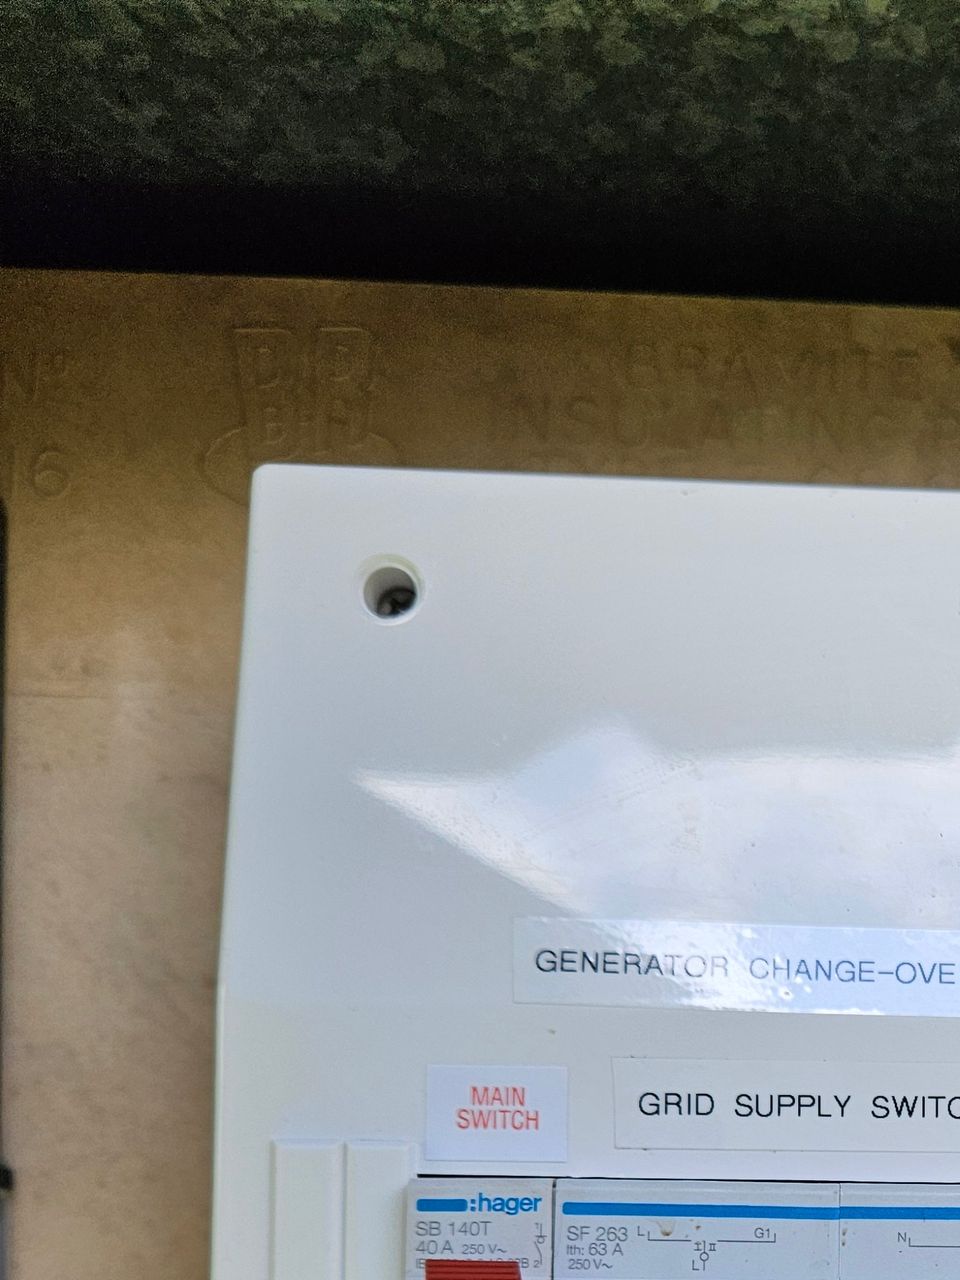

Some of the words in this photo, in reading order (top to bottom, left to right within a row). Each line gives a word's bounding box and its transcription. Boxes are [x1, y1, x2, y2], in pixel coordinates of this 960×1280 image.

[533, 947, 731, 978] GENERATOR
[470, 1085, 526, 1107] MAIN
[638, 1092, 715, 1116] GRID
[734, 1093, 851, 1118] SUPPLY
[456, 1108, 541, 1131] SWITCH
[415, 1220, 441, 1237] SB
[448, 1220, 493, 1237] 140T
[566, 1225, 591, 1242] SF
[595, 1226, 628, 1242] 263
[752, 1226, 773, 1241] G1
[897, 1231, 908, 1243] N
[415, 1239, 438, 1255] 40
[440, 1239, 454, 1254] A
[461, 1243, 485, 1255] 250
[588, 1242, 608, 1257] 63
[611, 1242, 624, 1257] A
[567, 1258, 591, 1271] 250
